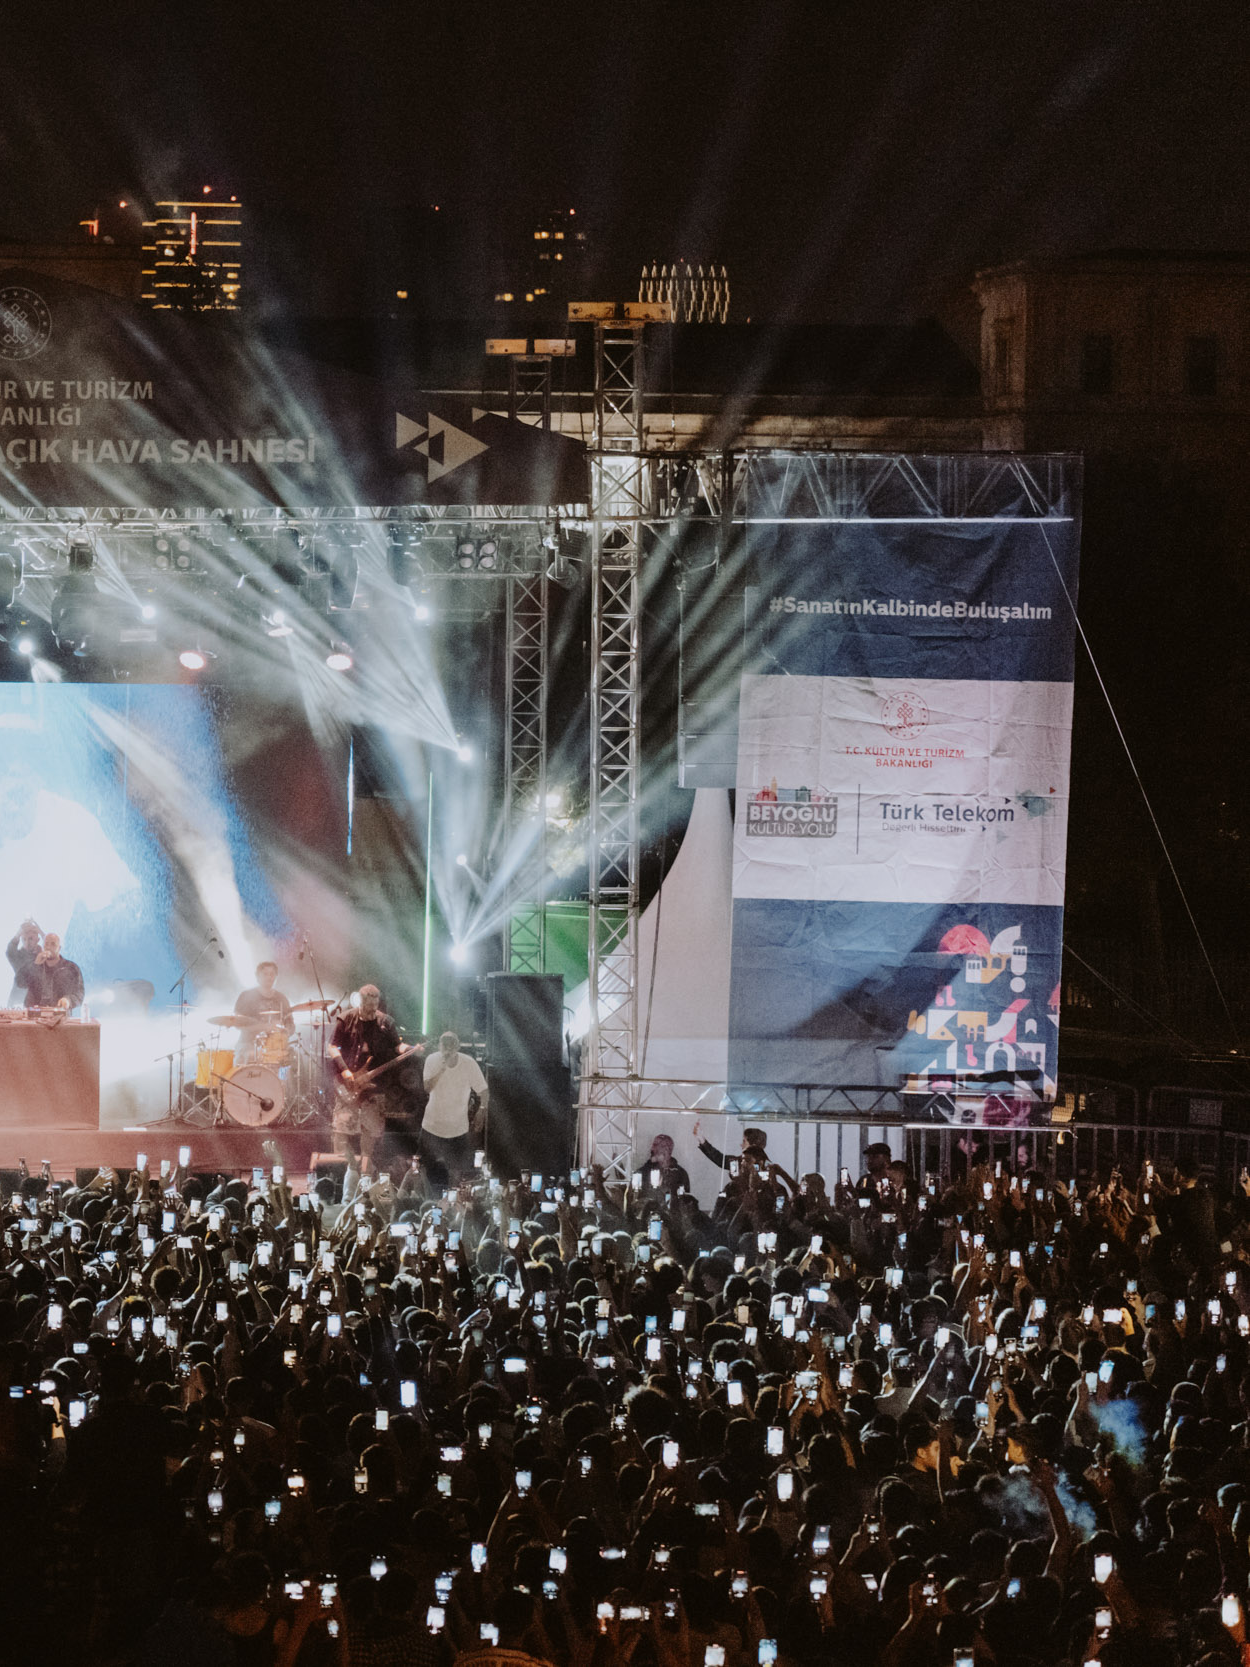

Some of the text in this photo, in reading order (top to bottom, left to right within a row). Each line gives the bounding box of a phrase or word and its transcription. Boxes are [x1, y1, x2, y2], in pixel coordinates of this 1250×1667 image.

[25, 381, 54, 400] VE
[60, 377, 154, 400] TURİZM
[71, 438, 163, 464] HAVA
[170, 433, 316, 464] SAHNESİ
[769, 596, 1052, 624] #SanatınKalbindeBuluşalım
[908, 747, 922, 757] VE
[879, 802, 1015, 822] Türk Telekom
[798, 822, 835, 836] YOLU
